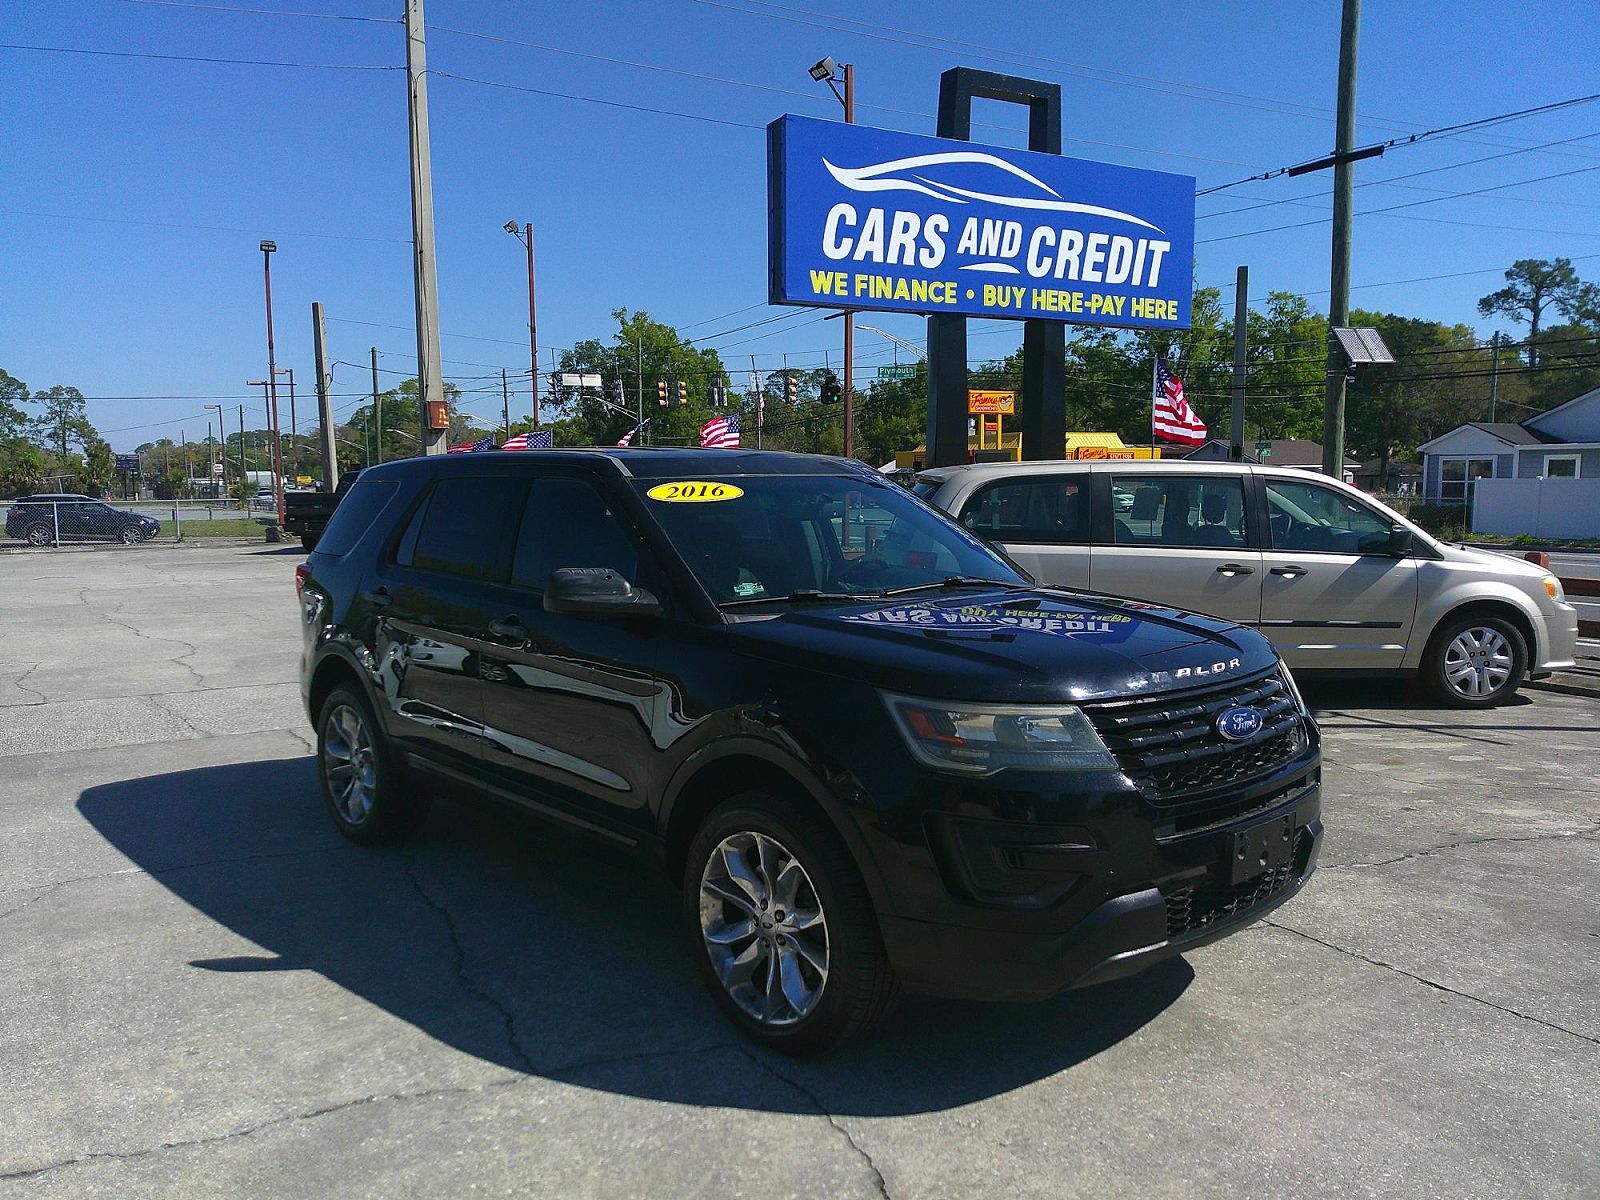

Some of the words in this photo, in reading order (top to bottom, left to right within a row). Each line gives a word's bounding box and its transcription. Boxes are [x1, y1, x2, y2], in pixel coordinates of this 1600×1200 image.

[822, 203, 950, 269] CARS
[956, 217, 1023, 258] AND
[1026, 225, 1171, 288] CREDIT
[809, 269, 849, 296] WE
[854, 274, 958, 304] FINANCE
[983, 284, 1027, 309] BUY
[1031, 288, 1127, 317] HERE-PAY
[1131, 297, 1179, 321] HERE
[665, 485, 724, 498] 2016
